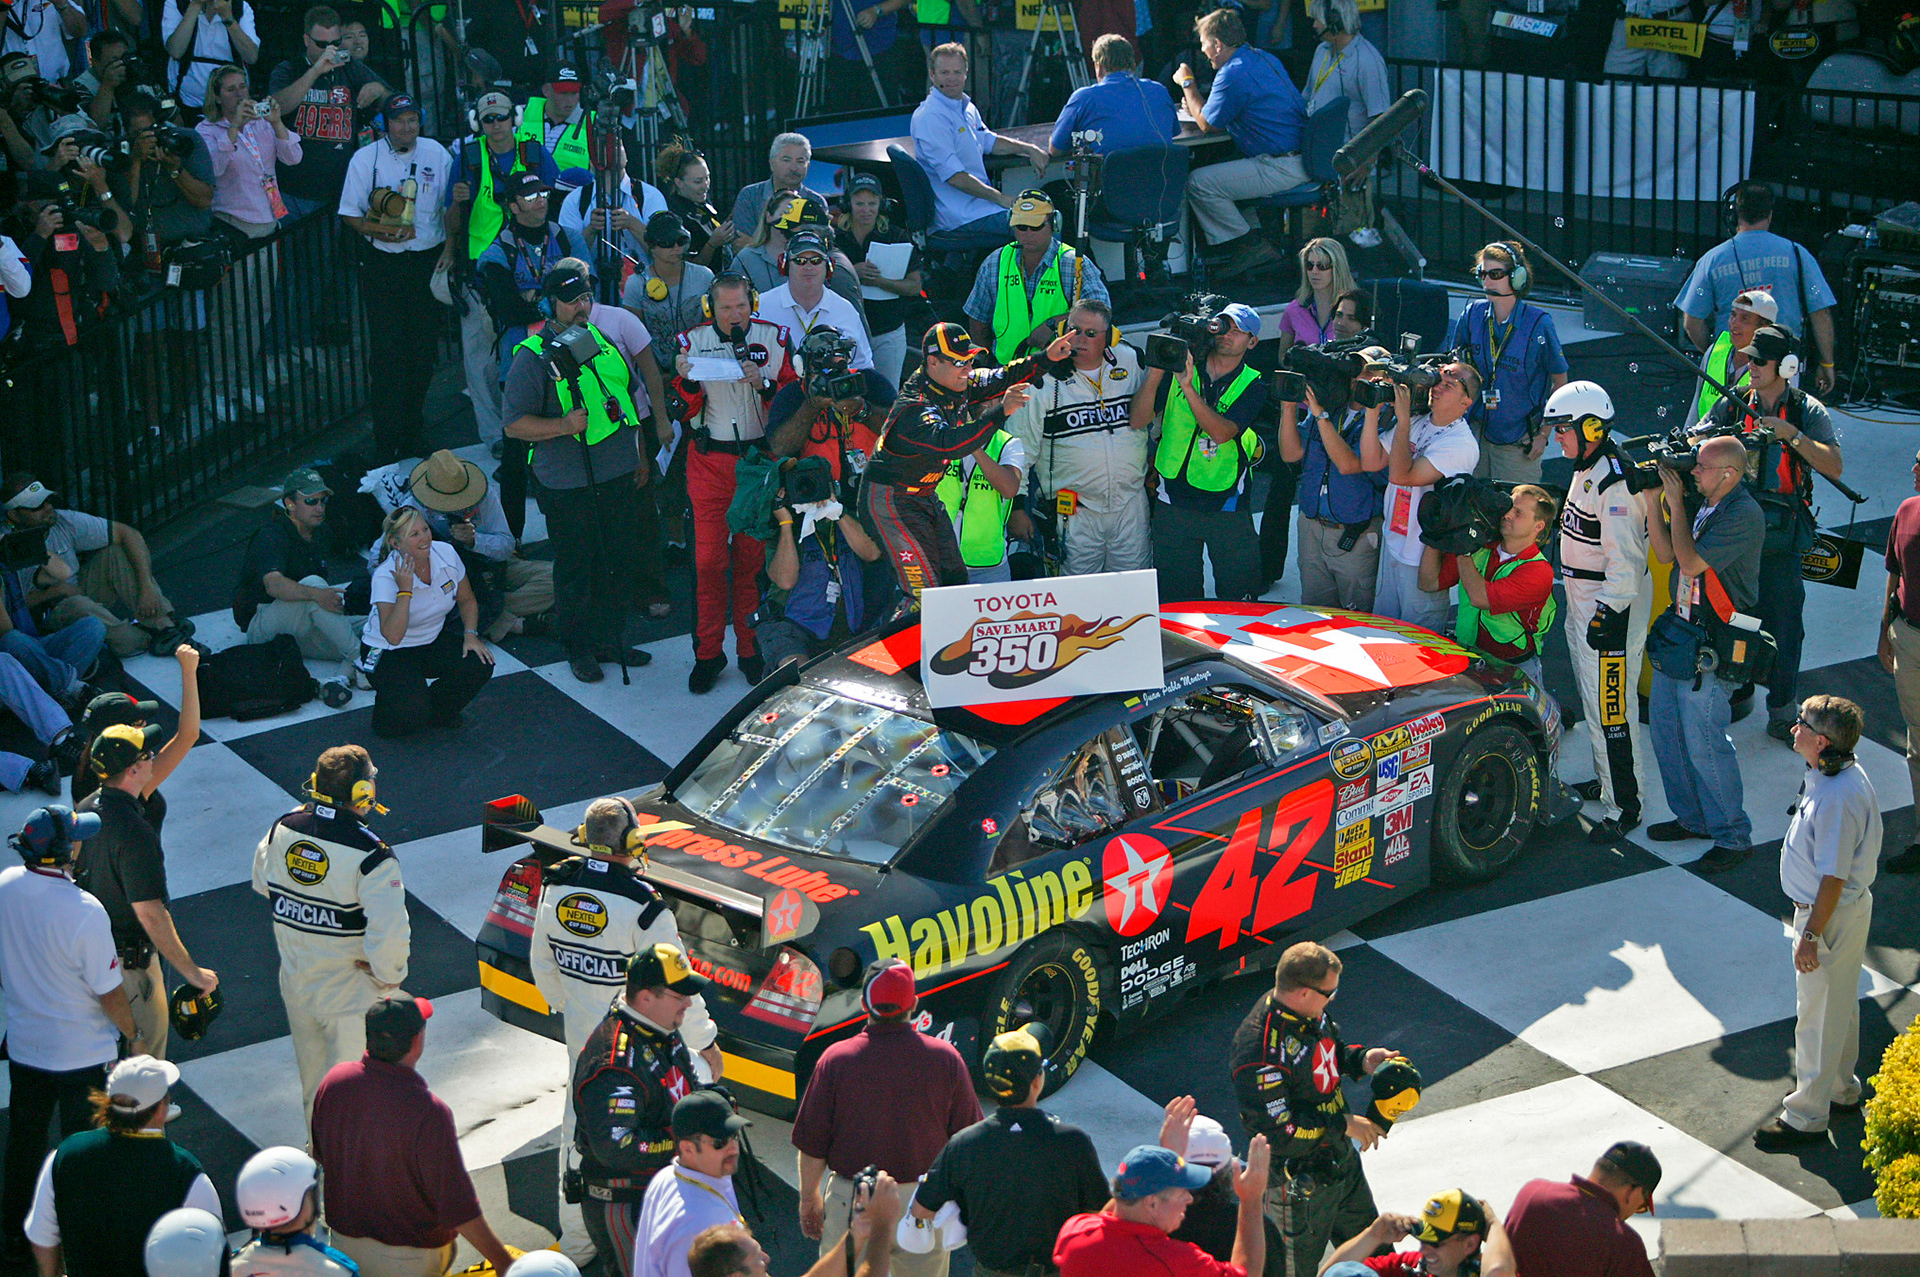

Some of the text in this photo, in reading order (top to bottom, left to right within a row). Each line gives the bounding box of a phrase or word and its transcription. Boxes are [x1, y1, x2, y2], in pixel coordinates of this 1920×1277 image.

[1631, 25, 1688, 40] NEXTEL
[294, 104, 352, 140] 49ERS
[1741, 258, 1760, 271] THE
[1761, 256, 1790, 268] NEED
[750, 352, 766, 360] TNT
[1066, 404, 1129, 428] OFFICIAL
[974, 592, 1057, 612] TOYOTA
[976, 620, 1057, 636] SAVE MART
[967, 633, 1058, 677] 350
[1143, 670, 1212, 706] Juan Pablo Montoya
[1606, 662, 1620, 723] NEXTEL
[1407, 715, 1445, 737] Holley
[1339, 752, 1365, 766] NEXTEL
[1379, 754, 1399, 779] USG
[1126, 772, 1147, 787] BOSCH
[1338, 778, 1370, 802] Bud
[1410, 771, 1431, 791] EA
[1527, 755, 1541, 815] EAGLE
[1407, 785, 1431, 800] SPORTS
[1337, 799, 1374, 826] Commit
[1385, 804, 1412, 836] 3M
[1345, 830, 1367, 844] Meter
[1346, 823, 1364, 835] Auto
[292, 857, 318, 872] NEXTEL
[301, 848, 321, 861] NASCAR
[1184, 778, 1335, 950] 42
[1336, 840, 1373, 870] Stant
[1385, 849, 1410, 865] TOOLS
[293, 868, 316, 880] CUP SERIES
[1334, 858, 1372, 889] JEGS
[275, 895, 342, 928] OFFICIAL
[566, 909, 597, 924] NEXTEL
[577, 900, 600, 913] NASCAR
[569, 921, 595, 932] CUP SERIES
[859, 860, 1094, 981] Havoline
[1120, 928, 1170, 962] TECHRON
[555, 947, 625, 978] OFFICIAL
[1121, 957, 1149, 980] DELL
[1121, 955, 1185, 993] DODGE
[775, 967, 818, 998] 42
[1066, 948, 1100, 1076] GOODYEAR
